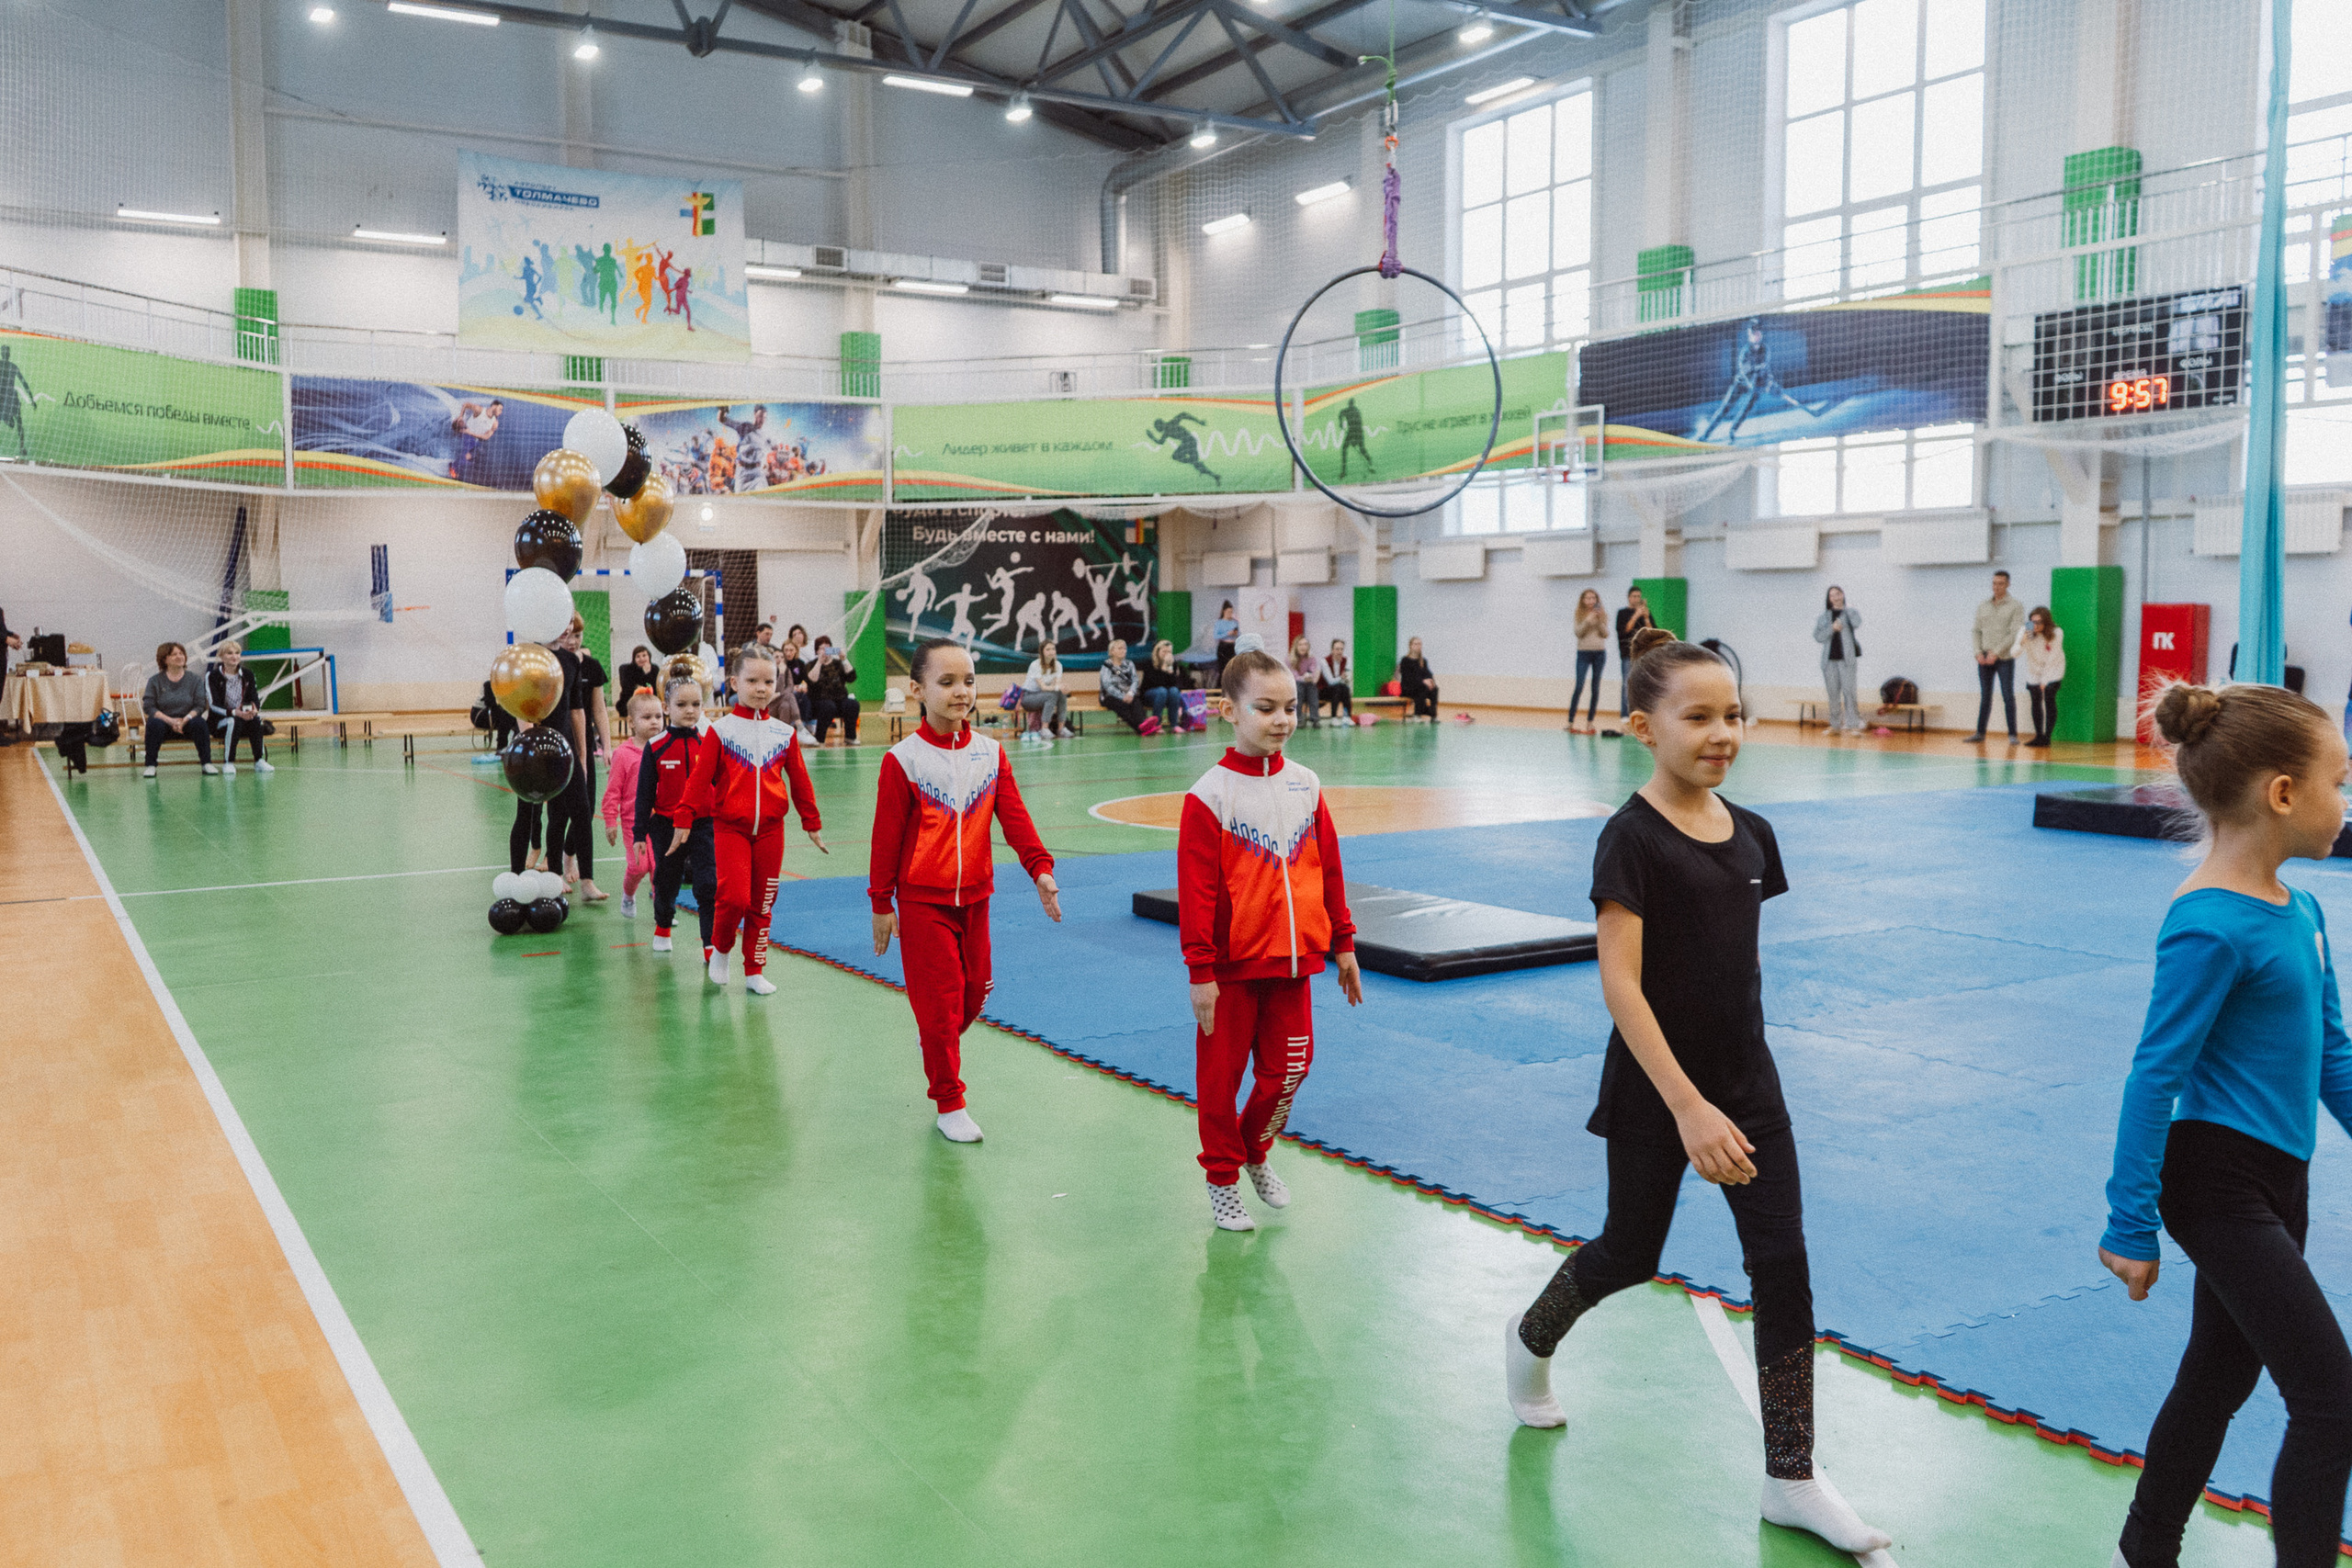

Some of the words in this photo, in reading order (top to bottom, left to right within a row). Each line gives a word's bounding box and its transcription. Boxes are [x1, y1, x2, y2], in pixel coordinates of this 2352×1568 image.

[514, 188, 598, 207] ТОЛМАЧЕВО
[62, 391, 143, 417] Добьемся
[146, 404, 200, 424] победы
[202, 412, 251, 431] вместе
[2109, 376, 2168, 412] 9:57
[942, 442, 989, 457] Лидер
[990, 442, 1037, 454] живет
[1041, 442, 1049, 453] в
[1053, 440, 1114, 453] каждом
[912, 525, 958, 545] Будь
[962, 527, 1027, 544] вместе
[1030, 530, 1041, 544] с
[1045, 528, 1095, 544] нами!
[2152, 631, 2176, 650] ПК
[918, 777, 956, 821] НОВОС
[1230, 816, 1281, 871] НОВОС
[1282, 1034, 1310, 1095] ПТИЦА
